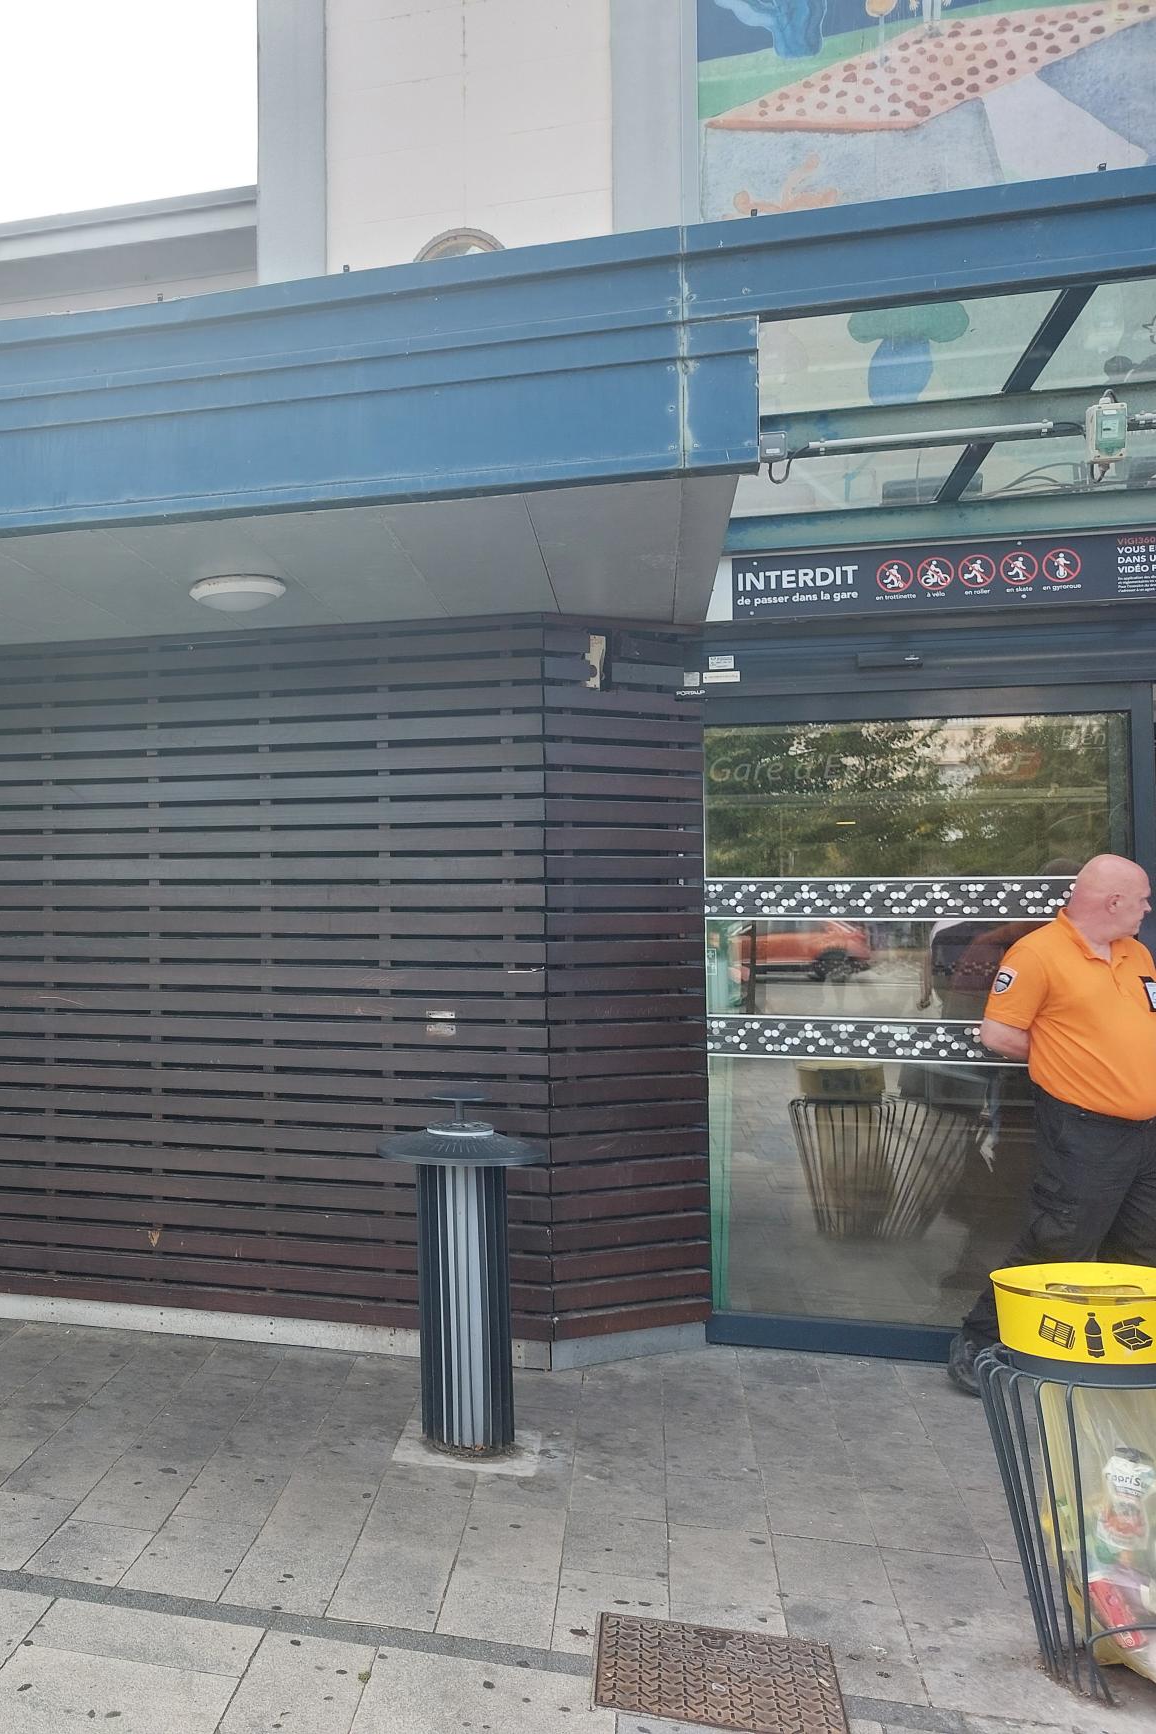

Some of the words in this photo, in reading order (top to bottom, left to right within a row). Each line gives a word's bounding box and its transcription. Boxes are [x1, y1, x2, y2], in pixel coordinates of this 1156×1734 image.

[1117, 545, 1146, 554] VOUS
[1117, 555, 1146, 564] DANS
[1117, 563, 1150, 573] VIDÉO
[737, 565, 859, 592] INTERDIT
[737, 596, 752, 606] de
[754, 595, 790, 607] passer
[792, 592, 818, 602] dans
[821, 590, 831, 600] la
[833, 591, 859, 602] gare
[709, 756, 784, 782] Gare
